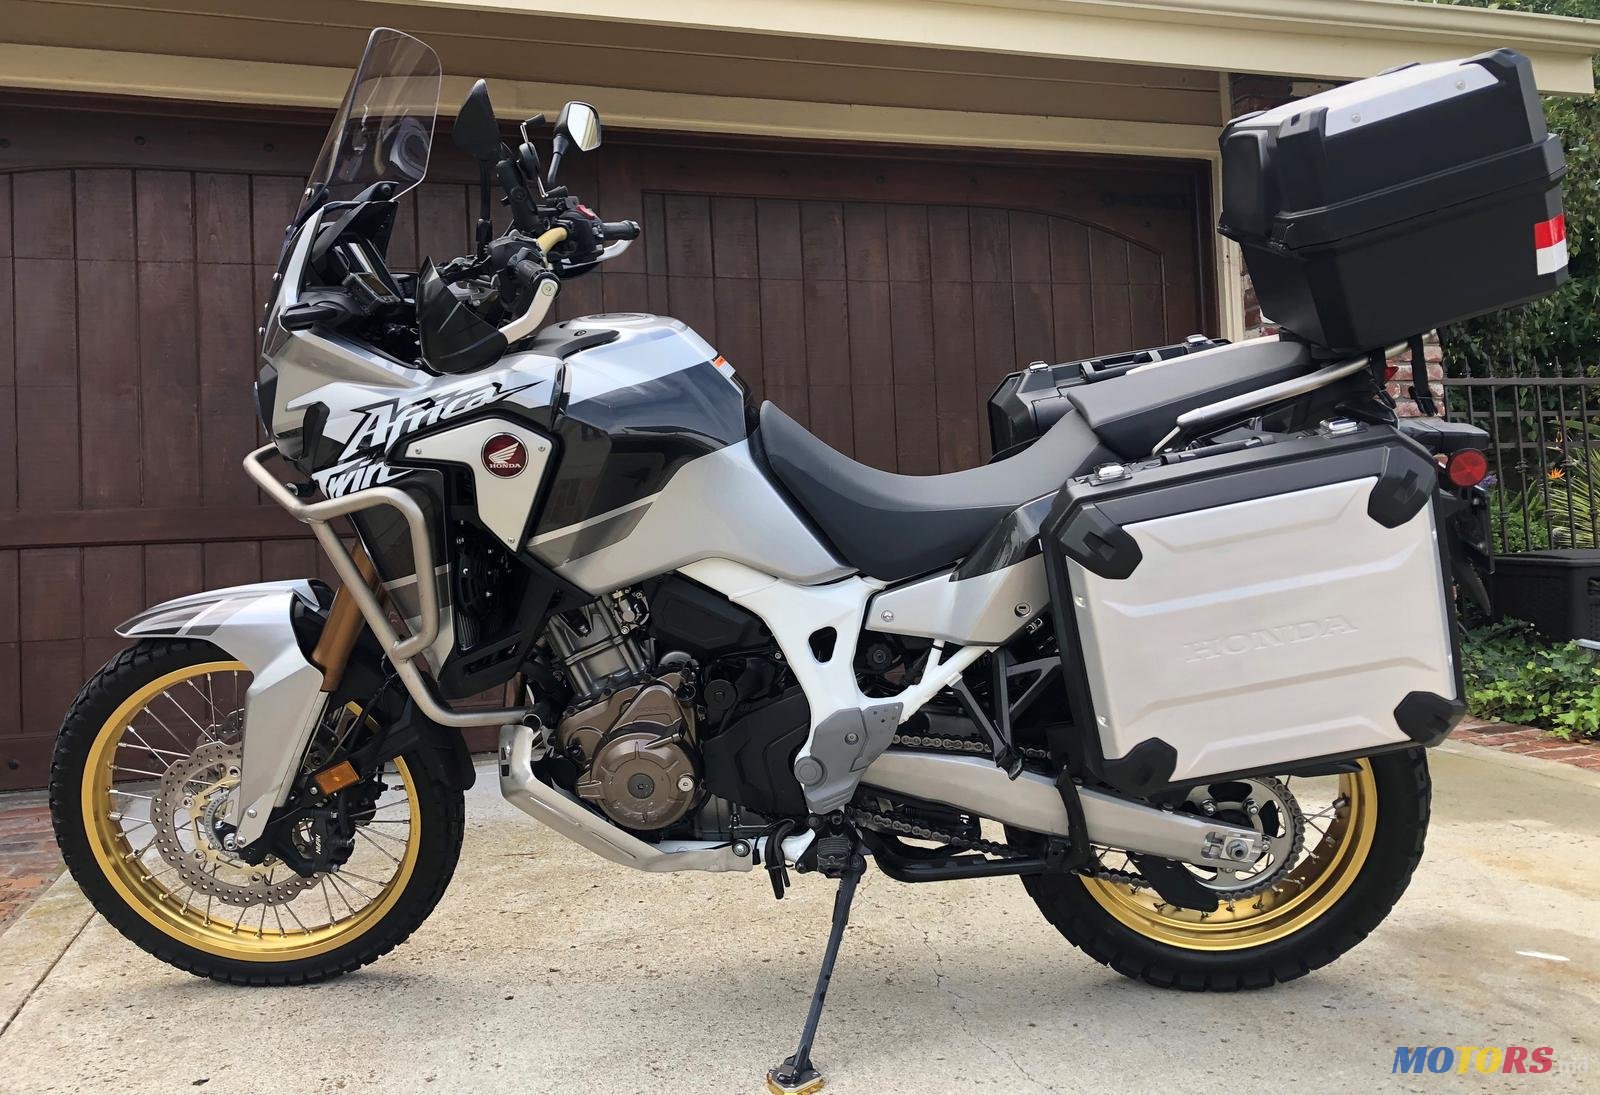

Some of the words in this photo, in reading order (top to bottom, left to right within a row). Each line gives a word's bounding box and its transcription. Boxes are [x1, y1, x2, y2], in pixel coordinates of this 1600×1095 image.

[337, 380, 540, 462] Africa
[312, 458, 414, 500] Twin
[1183, 614, 1359, 663] HONDA
